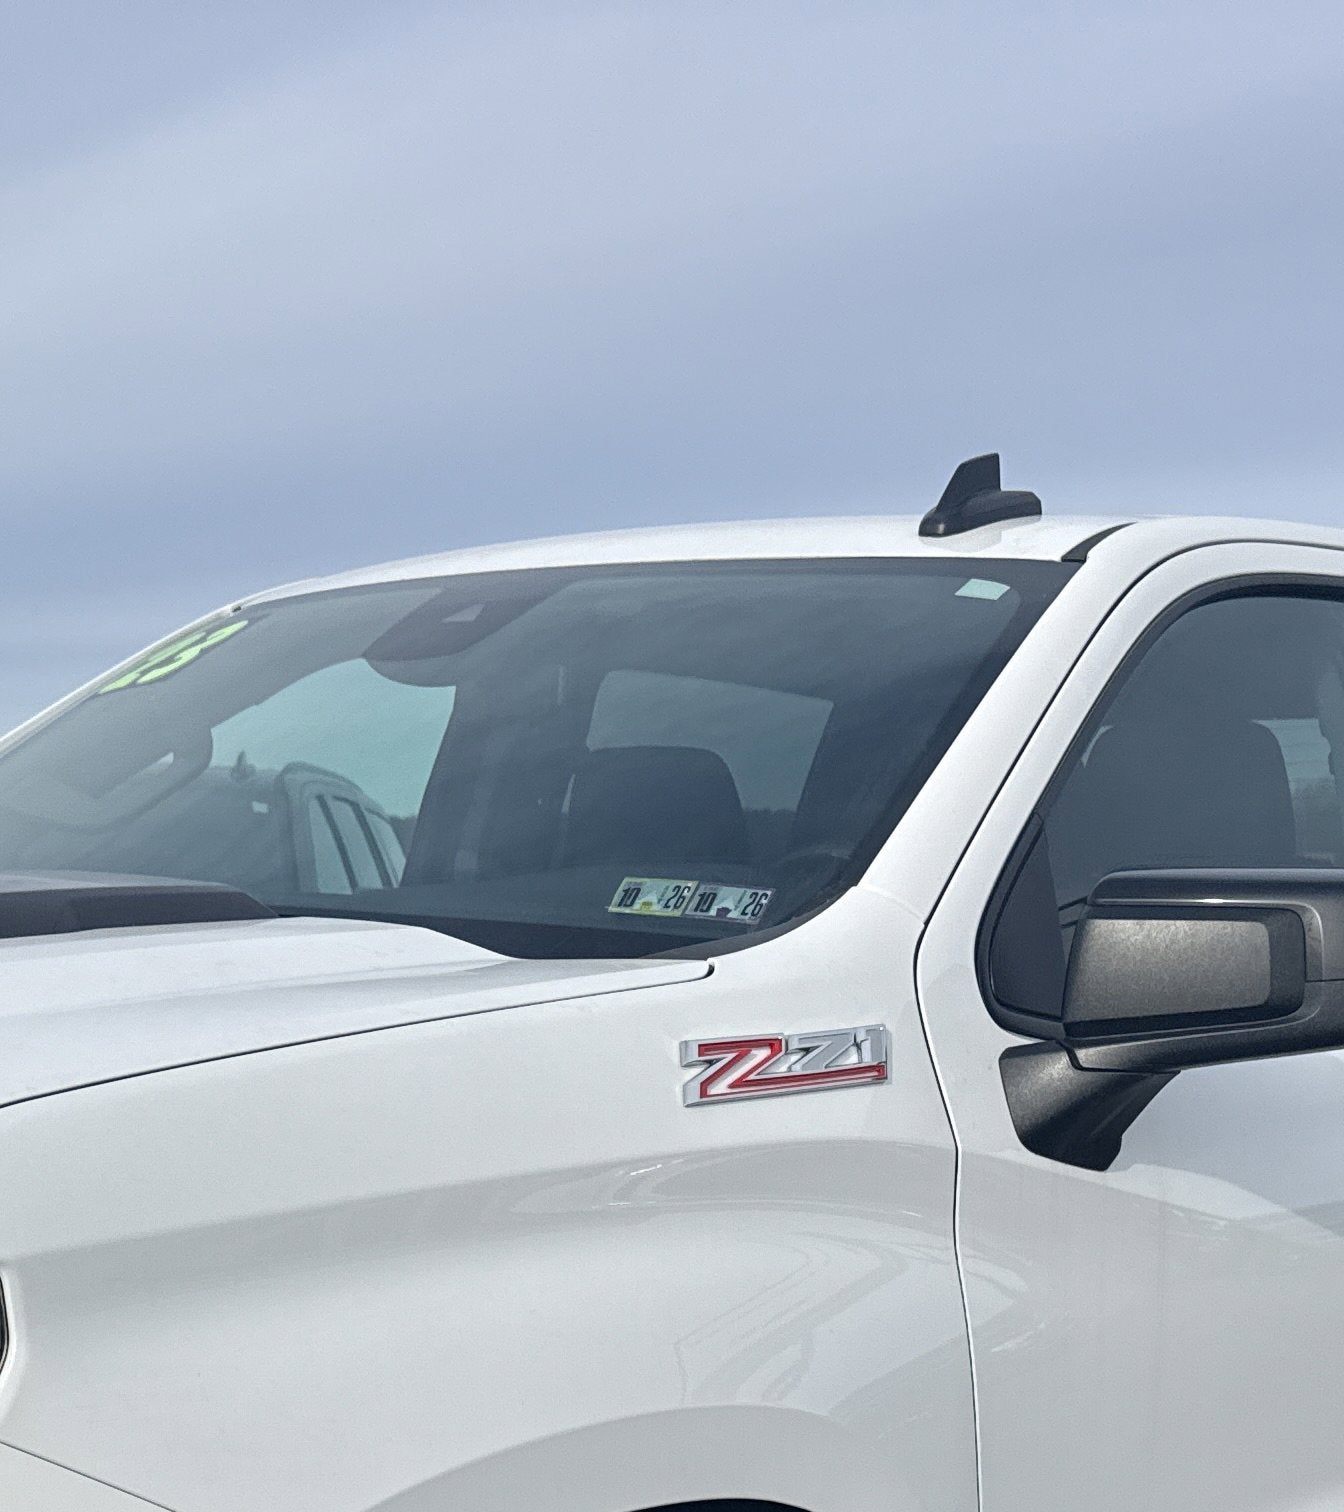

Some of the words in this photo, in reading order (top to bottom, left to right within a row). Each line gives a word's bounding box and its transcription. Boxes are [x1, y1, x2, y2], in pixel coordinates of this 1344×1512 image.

[618, 887, 641, 908] 10
[663, 885, 691, 909] 26
[693, 891, 717, 913] 10
[741, 892, 768, 916] 26
[679, 1024, 887, 1107] Z71
